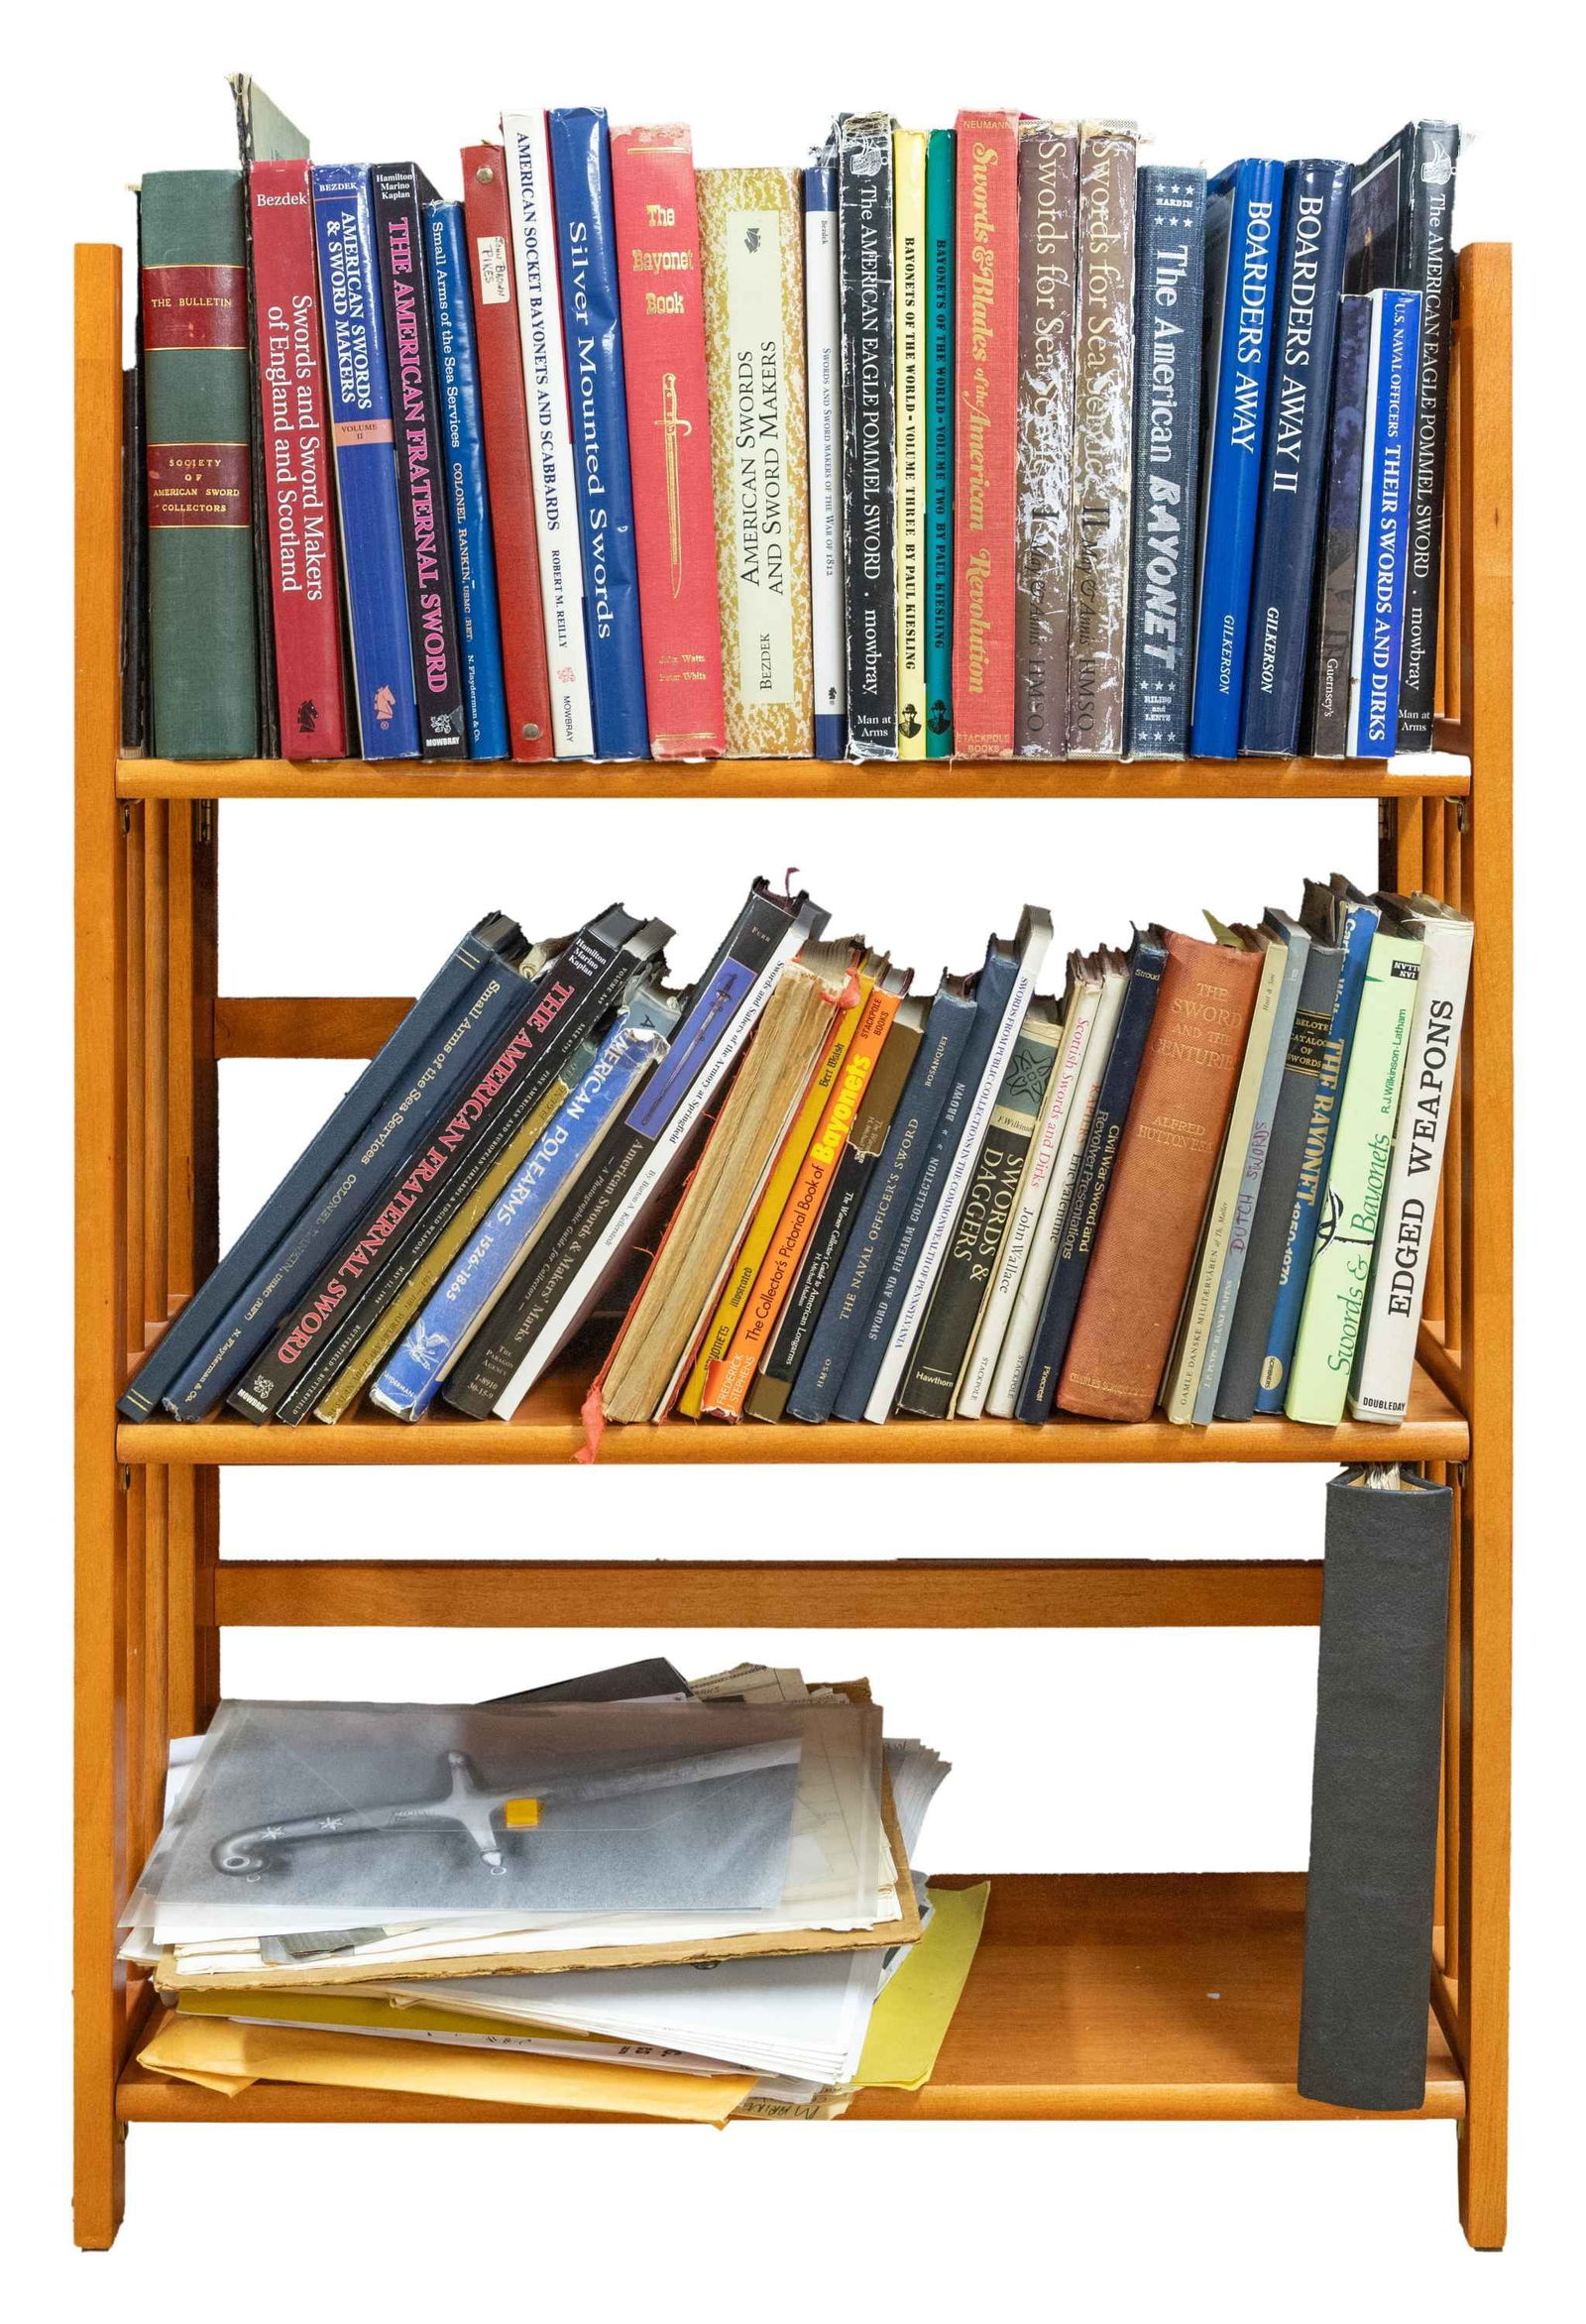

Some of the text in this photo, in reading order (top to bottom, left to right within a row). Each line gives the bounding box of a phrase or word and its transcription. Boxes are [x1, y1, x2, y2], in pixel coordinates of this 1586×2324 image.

[257, 193, 307, 207] Bezdek
[319, 182, 357, 191] BEZDEK
[376, 174, 413, 182] Hamilton
[381, 181, 410, 190] Marino
[382, 190, 410, 200] Kaplan
[646, 205, 675, 228] The
[482, 247, 495, 284] PIKES
[631, 250, 694, 274] Bayonet
[152, 297, 232, 308] THE BULLETIN
[327, 220, 356, 405] & SWORD MAKERS
[340, 212, 372, 409] AMERICAN SWORDS
[645, 292, 685, 315] Book
[1230, 200, 1273, 454] BOARDERS AWAY
[433, 222, 466, 524] Small Arms the Sea Services COLONEL
[1273, 195, 1324, 494] BOARDERS AWAY II
[516, 132, 568, 647] AMERICAN SOCKET BAYONETS AND SCABBARDS ROBERT REILLY
[963, 143, 998, 694] Swords Blades American Revolution
[266, 306, 301, 592] of England and Scotland
[292, 295, 326, 601] Swords and Sword Makers
[341, 423, 377, 432] VOLUME
[389, 217, 448, 693] THE AMERICAN FRATERNAL SWORD
[570, 221, 614, 639] Silver Mounted Swords
[861, 184, 882, 695] The AMERICAN EAGLE POMMEL SWORD mowbray
[905, 237, 916, 670] BAYONETS OF THE WORLD VOLUME THREE BY PAUL KIESLING
[170, 459, 221, 468] SOCIETY
[736, 350, 760, 587] AMERICAN SWORDS
[759, 341, 783, 596] AND SWORD MAKERS
[1143, 245, 1189, 670] The American BAYONET
[162, 504, 227, 513] COLLECTORS
[1368, 330, 1405, 742] NAVAL OFFICERS THEIR SWORDS AND DIRKS
[760, 634, 772, 691] BEZDEK
[1219, 615, 1235, 695] GILKERSON
[1260, 607, 1280, 694] GILKERSON
[1321, 658, 1338, 718] Guernsey's
[426, 737, 460, 747] MOWBRAY
[563, 695, 573, 743] MOWBRAY
[857, 715, 879, 725] Man
[861, 727, 888, 737] Arms
[751, 989, 767, 1007] and
[761, 960, 786, 991] Swords
[1135, 969, 1161, 982] Stroud
[734, 1005, 756, 1035] Sabers
[860, 998, 881, 1039] STACKPOLE
[874, 1011, 889, 1035] BOOKS
[700, 1056, 726, 1090] Armory
[925, 1037, 948, 1088] BOSANQUET
[667, 1098, 700, 1144] Springfield
[810, 1053, 872, 1165] Bayonets
[1030, 1017, 1089, 1188] Scottish Swords and Dirks
[278, 981, 574, 1364] THE AMERICAN FRATERNAL SWORD
[813, 1165, 824, 1180] of
[1388, 998, 1454, 1319] EDGED WEAPONS
[446, 1126, 570, 1302] POLEARMS 1526-1865
[798, 1181, 819, 1211] Book
[954, 1146, 1002, 1262] DAGGERS
[969, 1153, 1024, 1281] SWORDS &
[1062, 1171, 1094, 1260] Presentations
[1077, 1123, 1121, 1253] Civil War Sword and
[779, 1210, 807, 1259] Pictorial
[840, 1293, 855, 1321] THE
[853, 1245, 874, 1289] NAVAL
[868, 1174, 900, 1240] OFFICER'S
[894, 1118, 919, 1170] SWORD
[1230, 1194, 1256, 1253] DUTCH
[512, 1194, 610, 1344] Swords Makers' Marks
[999, 1208, 1034, 1294] John Wallace
[1327, 1132, 1390, 1376] Swords & Bayonets
[755, 1260, 787, 1319] Collector's
[745, 1319, 764, 1341] The
[717, 1353, 744, 1405] FREDERICK
[730, 1356, 754, 1403] STEPHENS
[915, 1371, 954, 1388] Hawthorn
[1363, 1396, 1405, 1412] DOUBLEDAY
